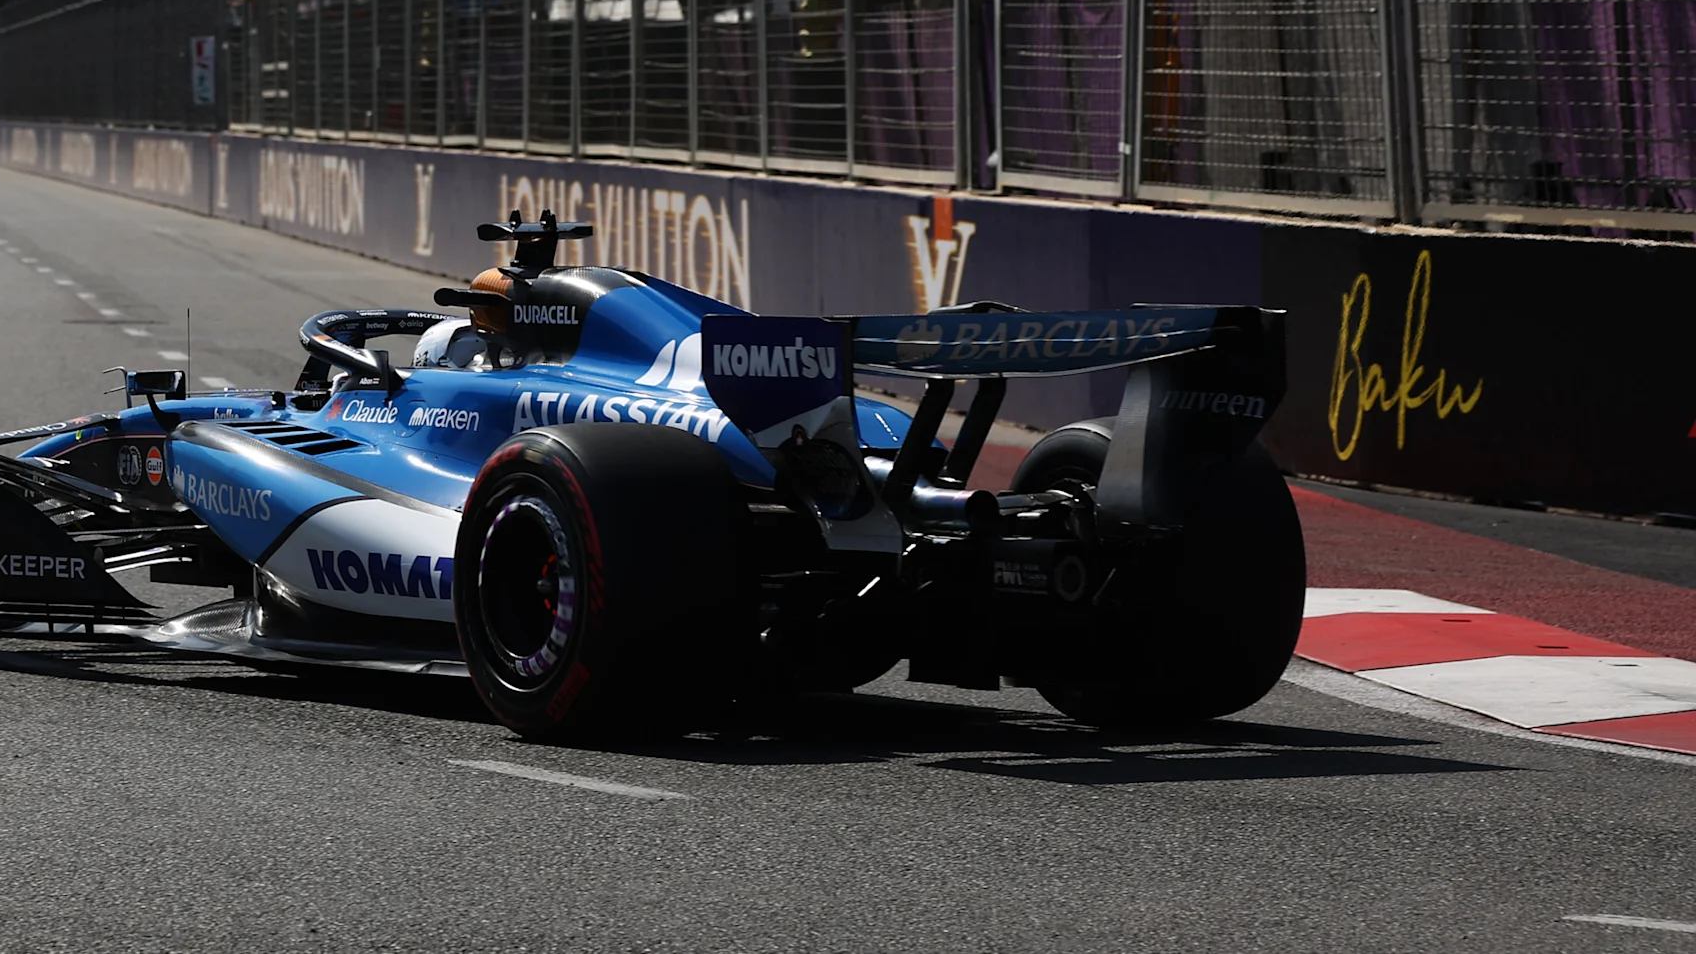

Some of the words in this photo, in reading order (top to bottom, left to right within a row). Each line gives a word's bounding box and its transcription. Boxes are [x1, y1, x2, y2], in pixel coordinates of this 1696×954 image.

[296, 153, 365, 235] VUITTON
[592, 182, 752, 312] VUITTON
[366, 322, 389, 330] betway
[513, 304, 579, 326] DURACELL
[946, 316, 1176, 362] BARCLAYS
[1327, 248, 1484, 462] Baku
[713, 342, 836, 380] KOMATSU
[341, 399, 397, 424] Claude
[512, 391, 732, 443] ATLASSIAN
[1158, 387, 1267, 420] nuveen
[119, 453, 142, 477] FIA
[147, 460, 162, 472] Gulf
[187, 473, 272, 522] BARCLAYS
[307, 548, 453, 600] KOMAT
